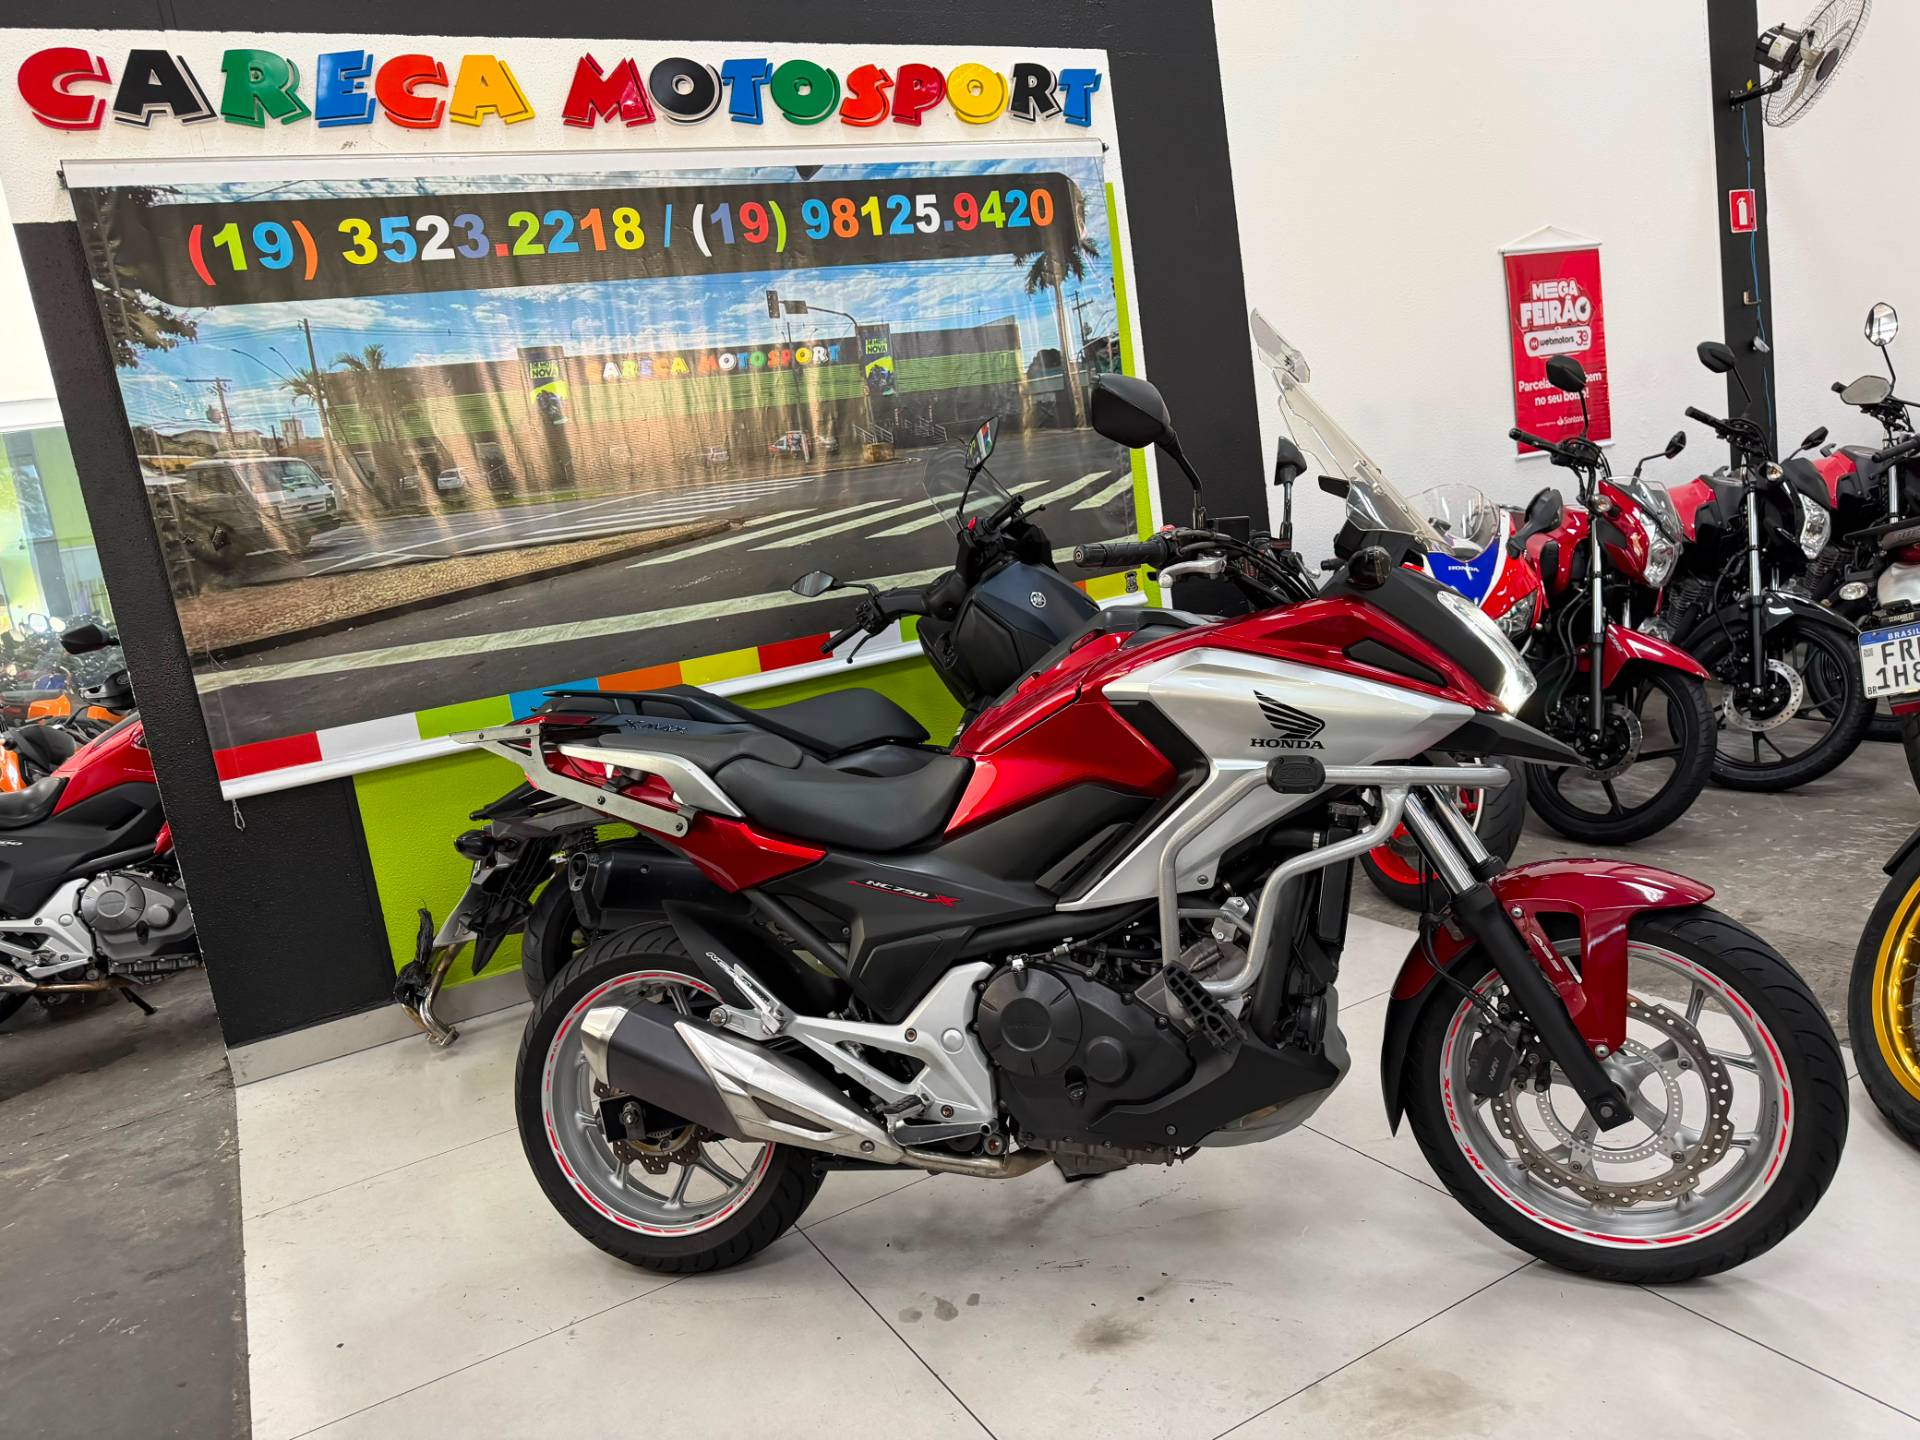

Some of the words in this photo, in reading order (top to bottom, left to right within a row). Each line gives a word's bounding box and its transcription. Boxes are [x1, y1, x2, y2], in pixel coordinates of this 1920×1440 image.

[18, 47, 534, 130] CARECA
[562, 52, 1100, 128] MOTOSPORT
[188, 220, 318, 286] (19)
[338, 207, 645, 266] 3523.2218
[692, 200, 787, 257] (19)
[801, 188, 1054, 240] 98125.9420
[1531, 280, 1578, 300] MEGA
[1520, 295, 1591, 328] FEIRÃO
[1540, 335, 1574, 346] webmotors
[1518, 377, 1554, 393] Parcela
[1535, 395, 1546, 407] no
[1547, 392, 1562, 405] seu
[1448, 565, 1480, 573] HONDA
[1888, 628, 1920, 640] BRASIL
[1881, 637, 1920, 665] FR
[1250, 738, 1325, 750] HONDA
